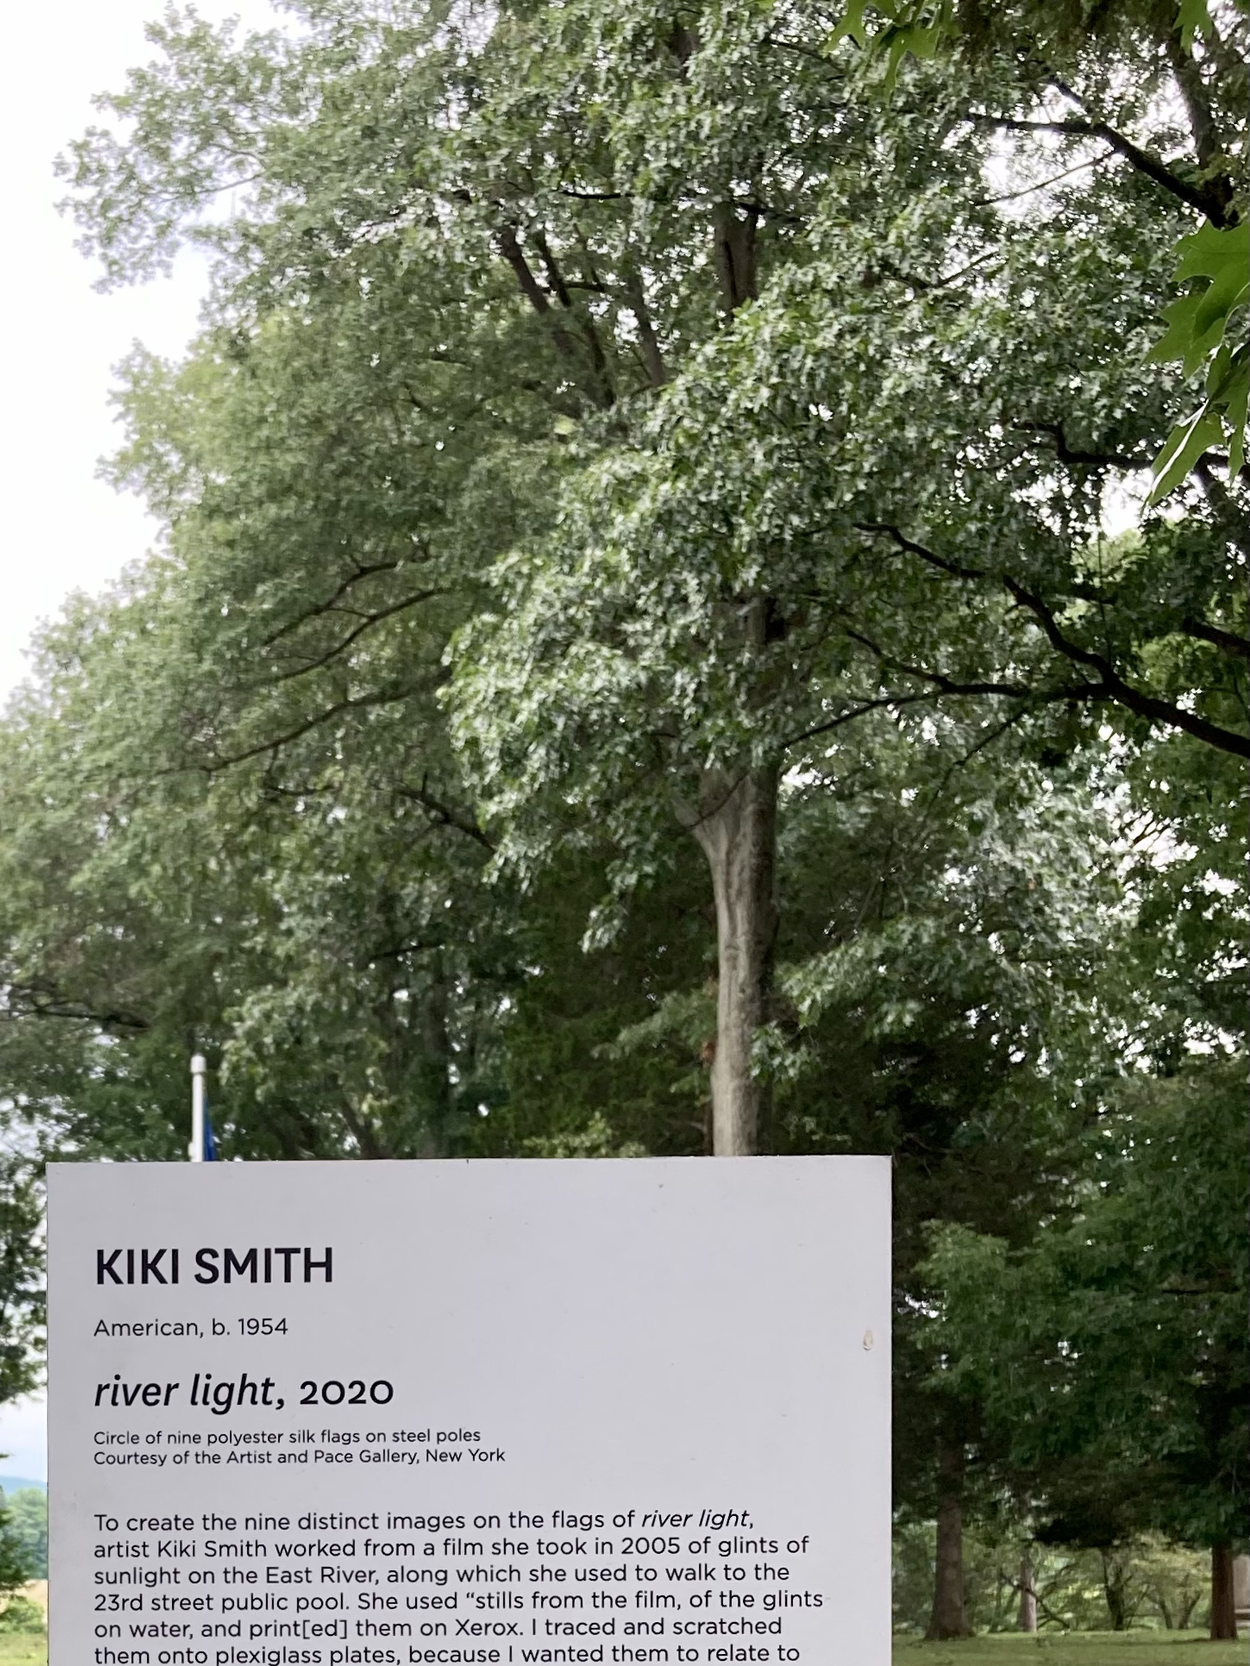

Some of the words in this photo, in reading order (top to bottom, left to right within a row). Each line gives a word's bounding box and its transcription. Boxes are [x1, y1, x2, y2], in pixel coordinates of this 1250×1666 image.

[96, 1248, 179, 1285] KIKI
[193, 1246, 333, 1285] SMITH
[93, 1318, 204, 1339] American,
[212, 1317, 231, 1336] b.
[237, 1317, 289, 1336] 1954
[94, 1373, 180, 1407] river
[190, 1372, 285, 1416] light,
[299, 1379, 394, 1406] 2020
[93, 1430, 140, 1445] Circle
[145, 1430, 163, 1445] of
[167, 1430, 202, 1445] nine
[207, 1429, 284, 1447] polyester
[288, 1429, 316, 1444] silk
[320, 1429, 361, 1446] flags
[365, 1432, 387, 1444] on
[391, 1428, 431, 1443] steel
[436, 1427, 481, 1445] poles
[93, 1451, 168, 1467] Courtesy
[172, 1450, 190, 1465] of
[194, 1450, 222, 1465] the
[226, 1450, 273, 1464] Artist
[277, 1449, 309, 1464] and
[314, 1449, 354, 1464] Pace
[358, 1448, 420, 1466] Gallery,
[425, 1448, 463, 1463] New
[467, 1447, 506, 1462] York
[93, 1513, 119, 1532] To
[126, 1514, 195, 1532] create
[201, 1512, 237, 1531] the
[244, 1512, 291, 1531] nine
[297, 1511, 380, 1531] distinct
[387, 1511, 466, 1533] images
[473, 1515, 501, 1529] on
[507, 1510, 545, 1529] the
[551, 1509, 605, 1532] flags
[612, 1509, 636, 1528] of
[641, 1509, 694, 1528] river
[698, 1508, 754, 1531] light,
[94, 1566, 181, 1588] sunlight
[188, 1570, 215, 1585] on
[222, 1565, 259, 1585] the
[266, 1566, 313, 1584] East
[320, 1565, 380, 1586] River,
[386, 1564, 448, 1587] along
[455, 1564, 521, 1583] which
[528, 1563, 567, 1583] she
[574, 1563, 627, 1582] used
[634, 1564, 658, 1582] to
[664, 1562, 717, 1582] walk
[723, 1563, 746, 1581] to
[754, 1562, 790, 1581] the
[94, 1646, 150, 1665] them
[157, 1647, 208, 1665] onto
[330, 1645, 401, 1666] plates,
[409, 1645, 501, 1664] because
[508, 1644, 513, 1663] I
[520, 1643, 604, 1663] wanted
[611, 1643, 669, 1663] them
[676, 1644, 700, 1663] to
[707, 1643, 770, 1662] relate
[776, 1644, 800, 1662] to
